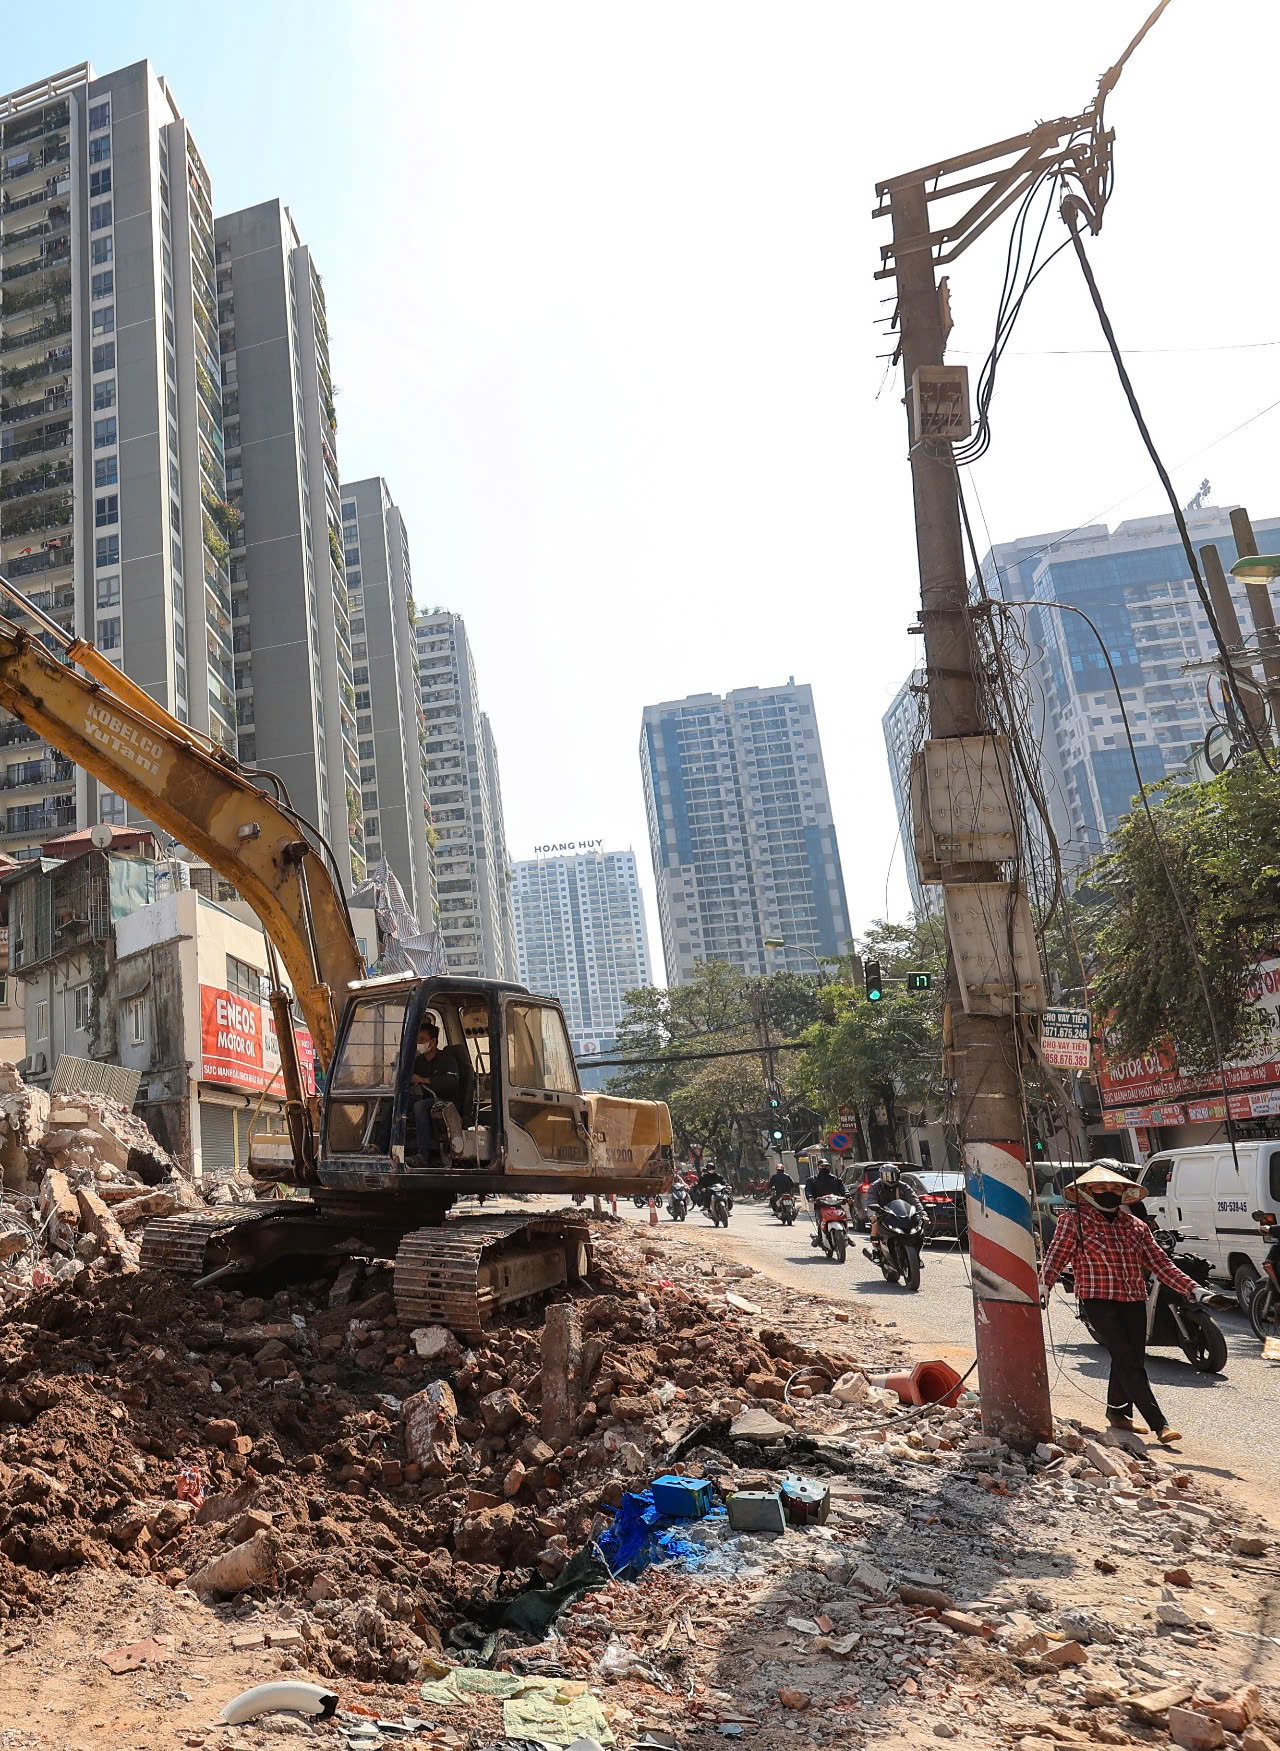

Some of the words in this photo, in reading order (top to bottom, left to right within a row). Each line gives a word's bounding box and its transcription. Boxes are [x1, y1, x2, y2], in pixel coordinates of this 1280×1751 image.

[87, 703, 163, 759] KOBELCO
[534, 842, 576, 853] HOANG
[578, 839, 603, 849] HUY
[916, 975, 928, 987] 17
[216, 998, 256, 1036] ENEOS
[1042, 1013, 1056, 1022] CHO
[1057, 1014, 1070, 1023] VAY
[1043, 1026, 1088, 1039] 971.675.246
[218, 1031, 245, 1055] MOTOR
[246, 1040, 256, 1057] OIL
[1042, 1040, 1056, 1049] CHO
[1058, 1041, 1071, 1050] VAY
